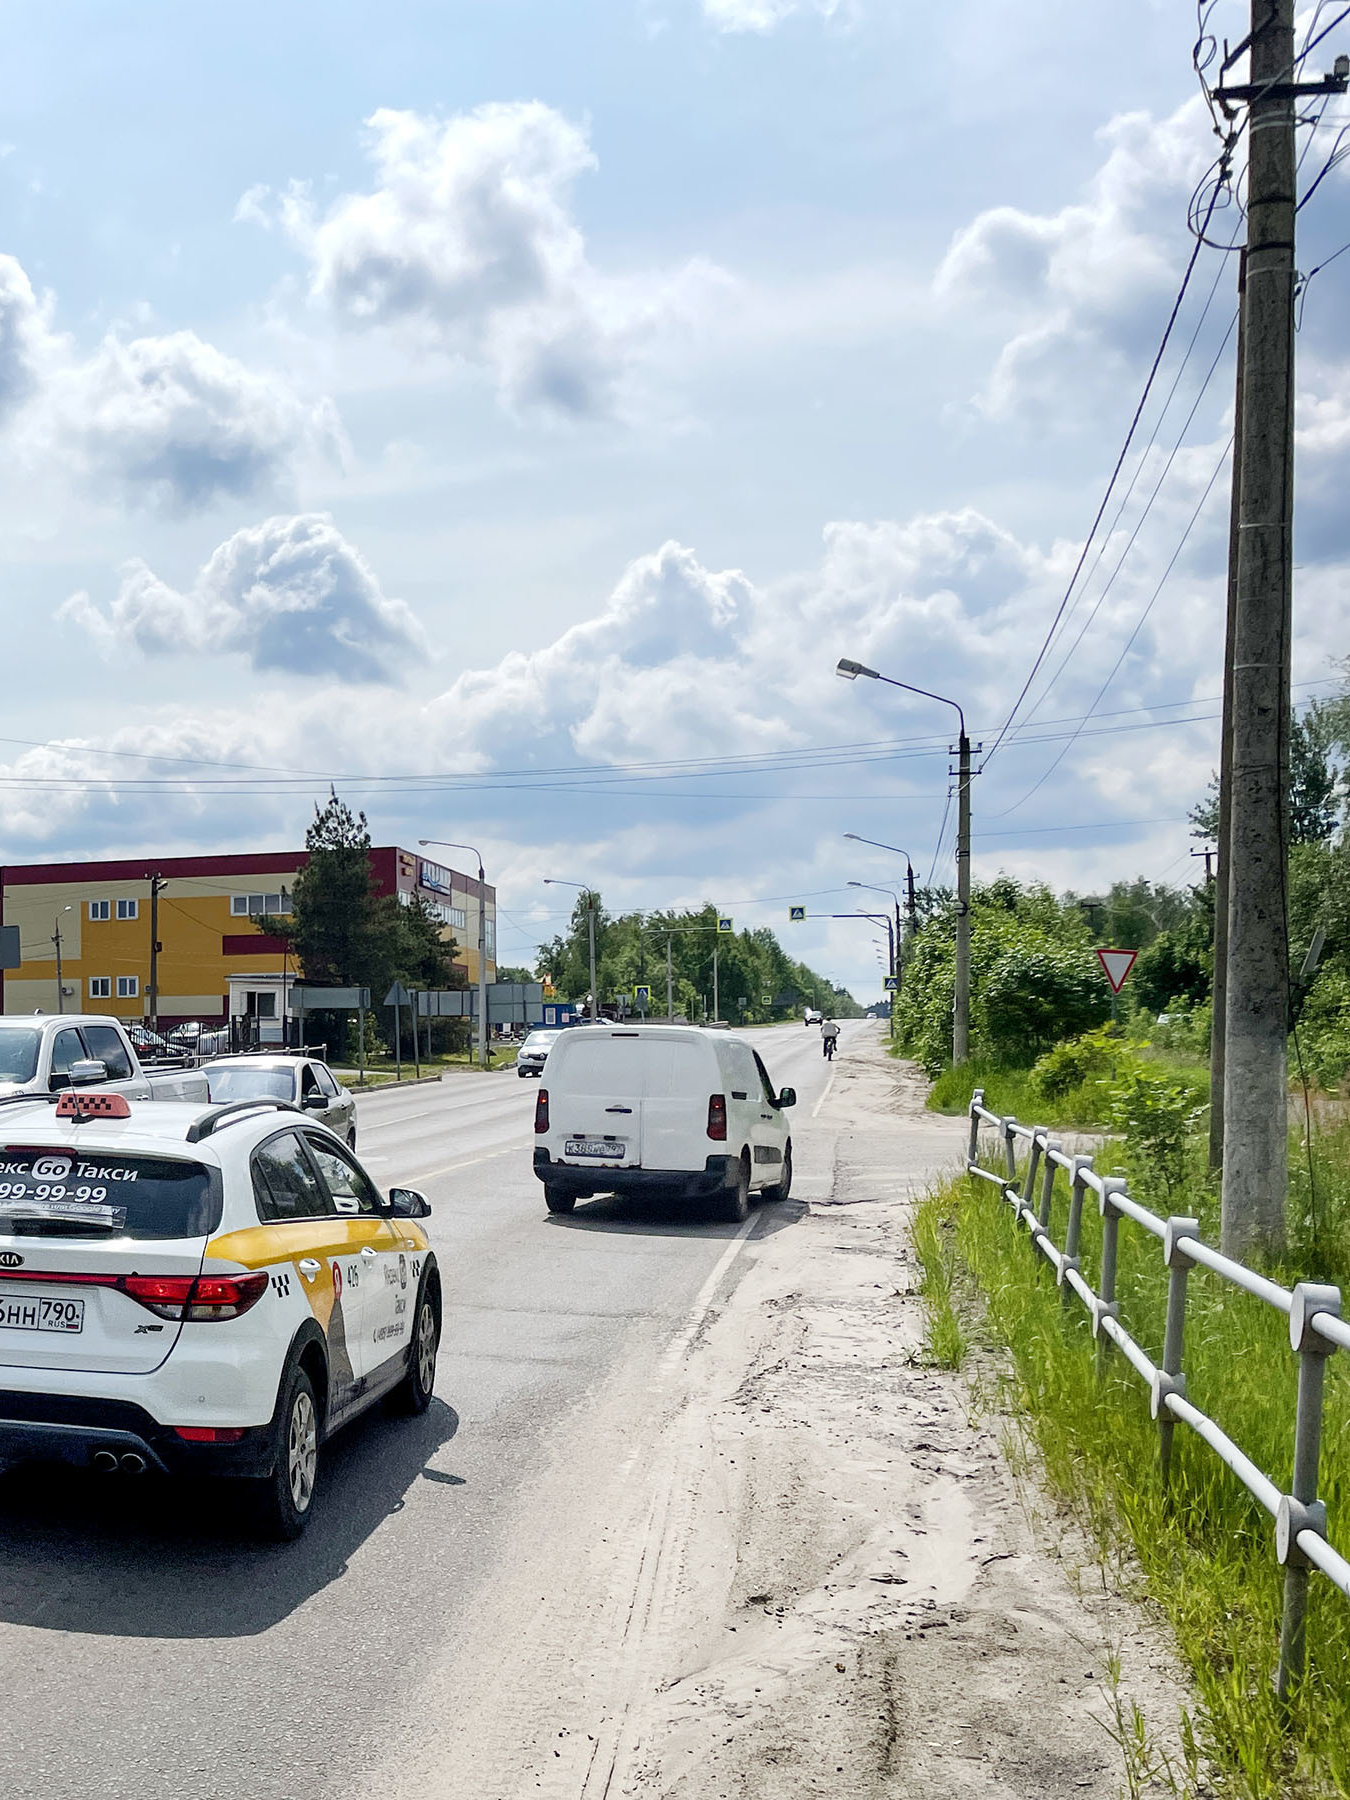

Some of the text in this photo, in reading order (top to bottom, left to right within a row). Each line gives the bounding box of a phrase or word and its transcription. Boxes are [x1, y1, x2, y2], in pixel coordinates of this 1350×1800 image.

[38, 1160, 66, 1175] Go
[77, 1162, 138, 1182] Такси
[41, 1300, 76, 1321] 790
[47, 1320, 66, 1329] RUS
